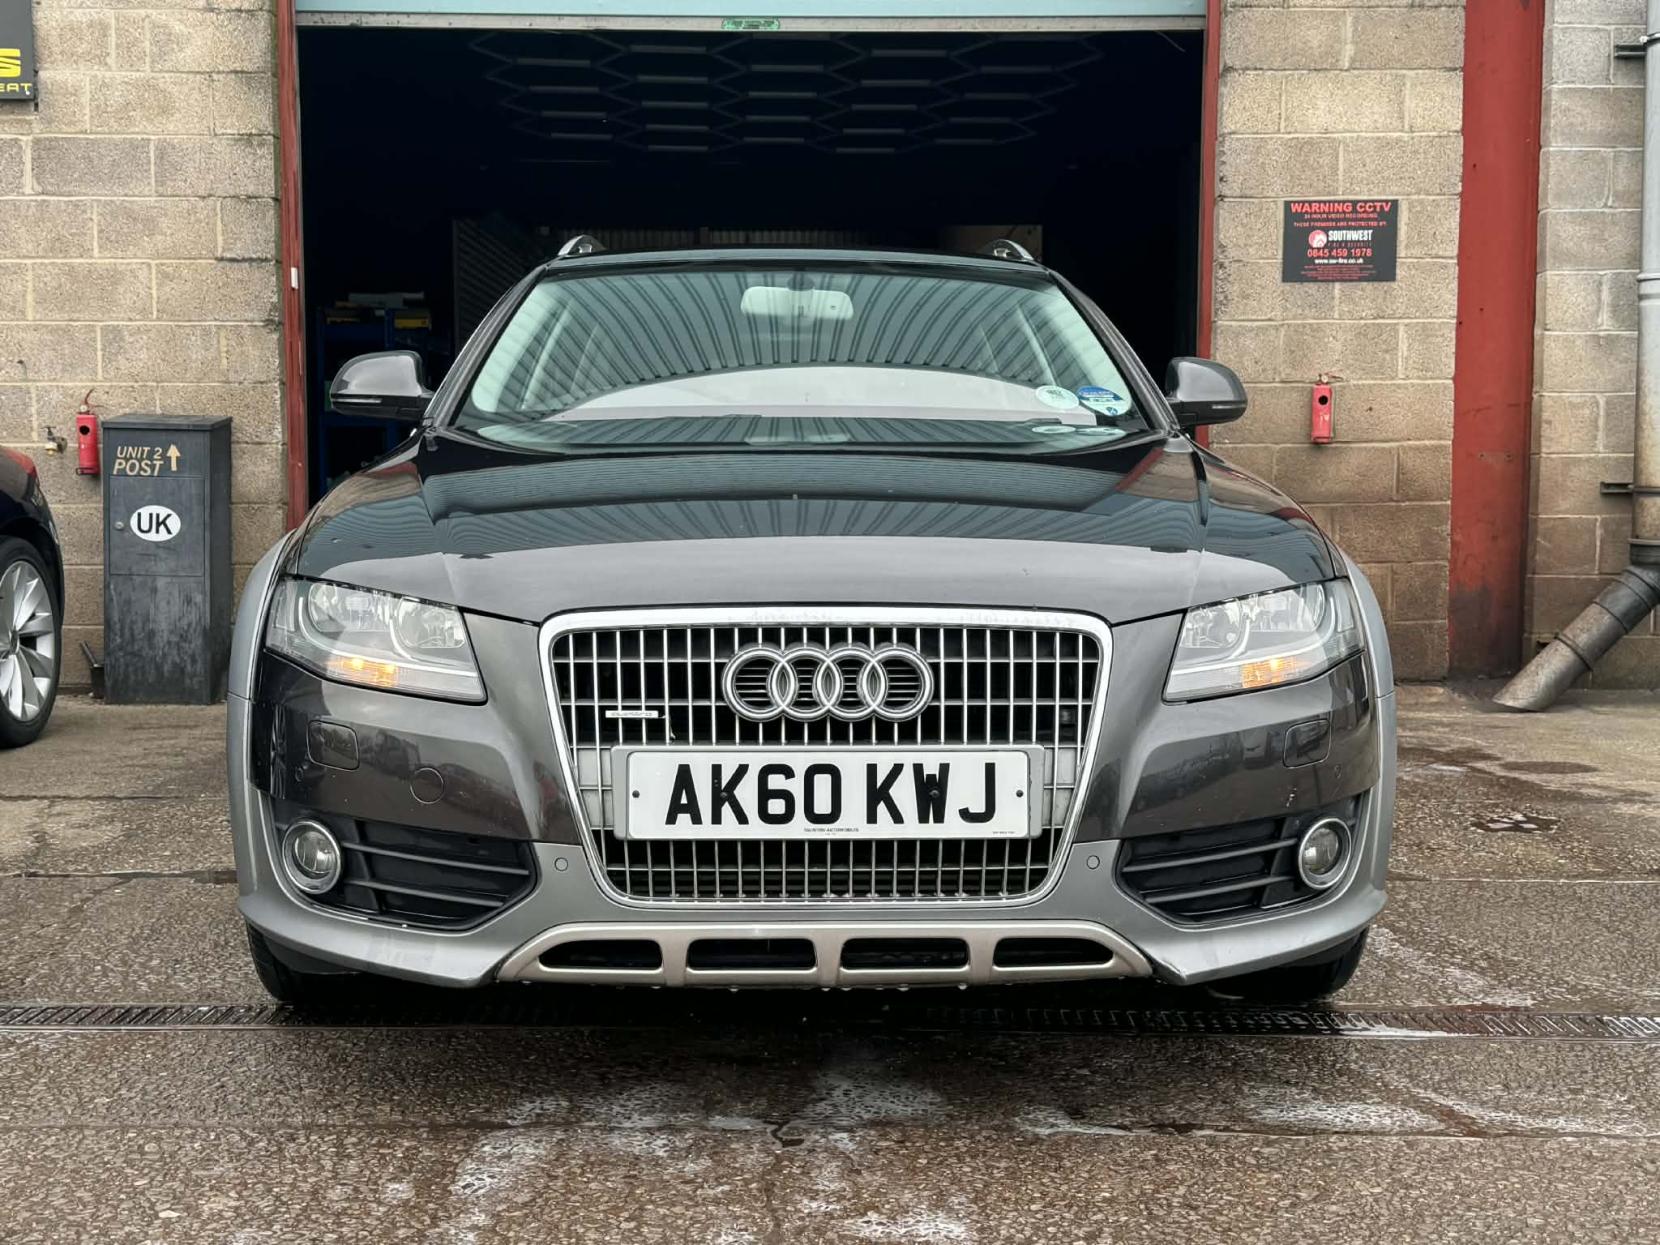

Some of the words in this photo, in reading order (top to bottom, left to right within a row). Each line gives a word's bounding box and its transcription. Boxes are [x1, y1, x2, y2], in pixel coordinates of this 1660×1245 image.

[1290, 202, 1352, 213] WARNING
[1356, 202, 1391, 212] CCTV
[1328, 230, 1373, 241] SOUTHWEST
[1307, 248, 1329, 257] 0845
[1331, 248, 1348, 257] 459
[1350, 248, 1373, 257] 1978
[116, 446, 151, 459] UNIT
[153, 447, 162, 459] 2
[113, 459, 164, 476] POST
[137, 511, 173, 535] UK
[666, 764, 841, 824] AK60
[867, 763, 995, 824] KWJ
